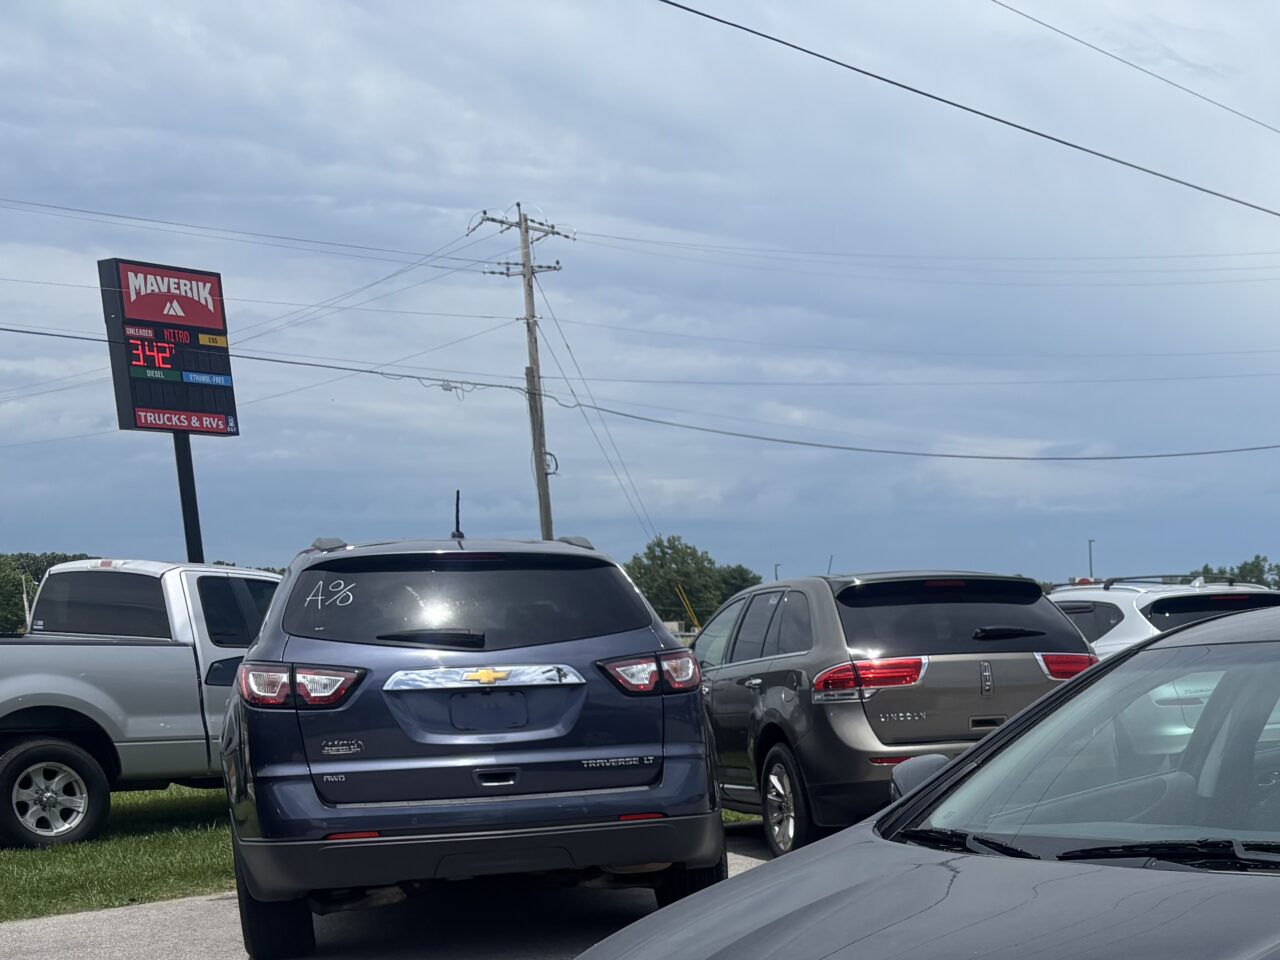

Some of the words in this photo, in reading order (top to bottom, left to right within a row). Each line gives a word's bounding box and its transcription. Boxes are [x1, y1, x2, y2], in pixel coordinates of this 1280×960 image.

[128, 271, 214, 313] MAVERIK
[126, 327, 153, 337] UNLEADED
[146, 370, 164, 379] DIESEL
[138, 411, 188, 426] TRUCKS
[191, 416, 200, 427] &
[203, 416, 224, 429] RVs
[880, 712, 926, 721] LINCOLN
[582, 757, 639, 768] TRAVERSE
[644, 756, 654, 764] LT
